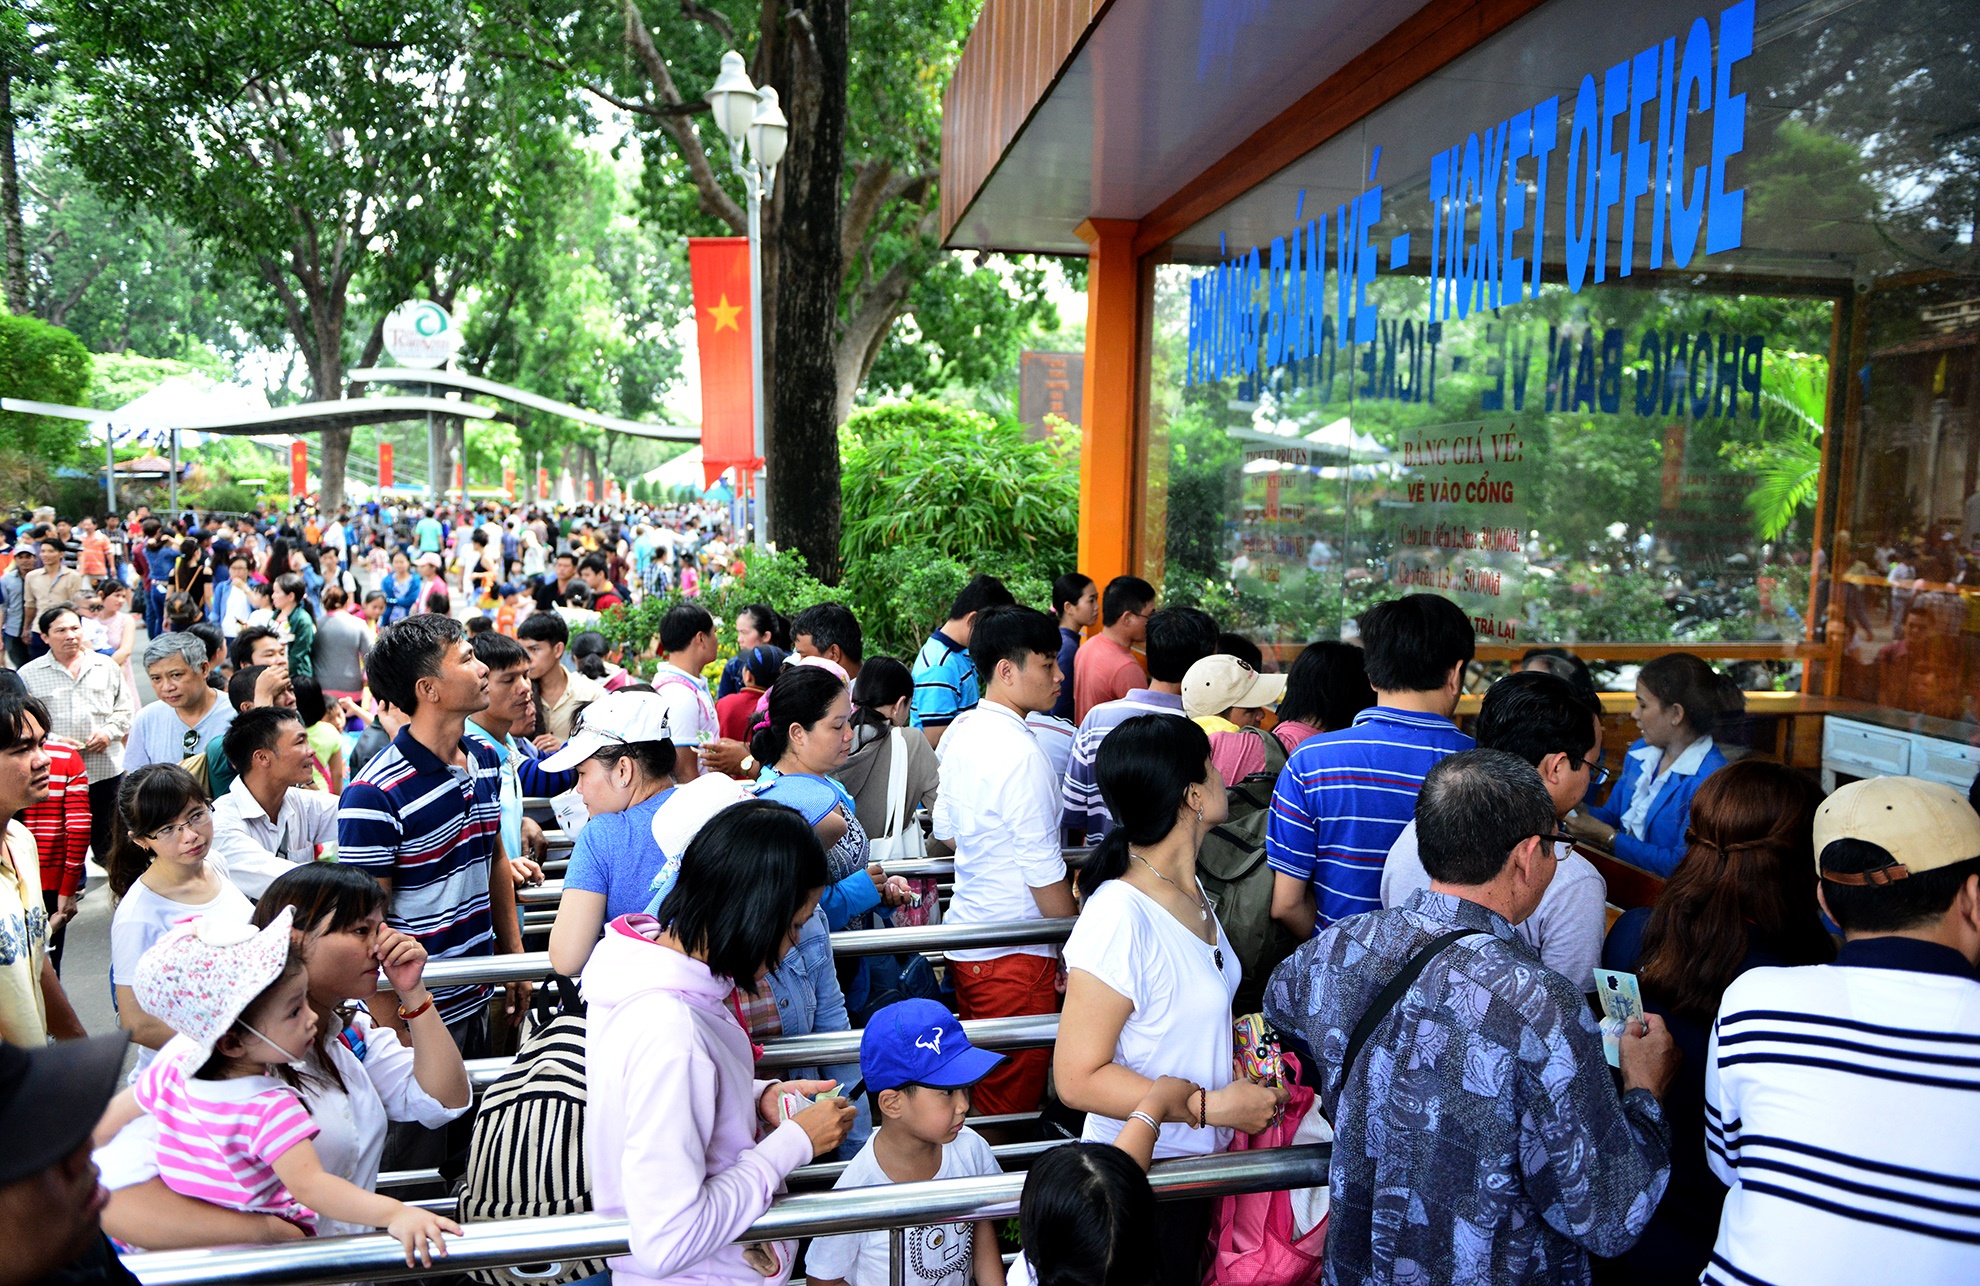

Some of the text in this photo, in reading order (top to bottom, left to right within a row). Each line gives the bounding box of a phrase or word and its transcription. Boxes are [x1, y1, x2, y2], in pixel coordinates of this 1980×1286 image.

[1187, 231, 1260, 386] PHÒNG
[1267, 189, 1328, 367] BÁN
[1338, 145, 1383, 349] VÉ
[1428, 95, 1559, 324] TICKET
[1566, 0, 1755, 294] OFFICE
[1404, 423, 1523, 467] BẢNG GIÁ VÉ:
[1430, 476, 1461, 503] VÀO
[1465, 470, 1514, 503] CỔNG
[1474, 613, 1516, 644] TRẢ LẠI
